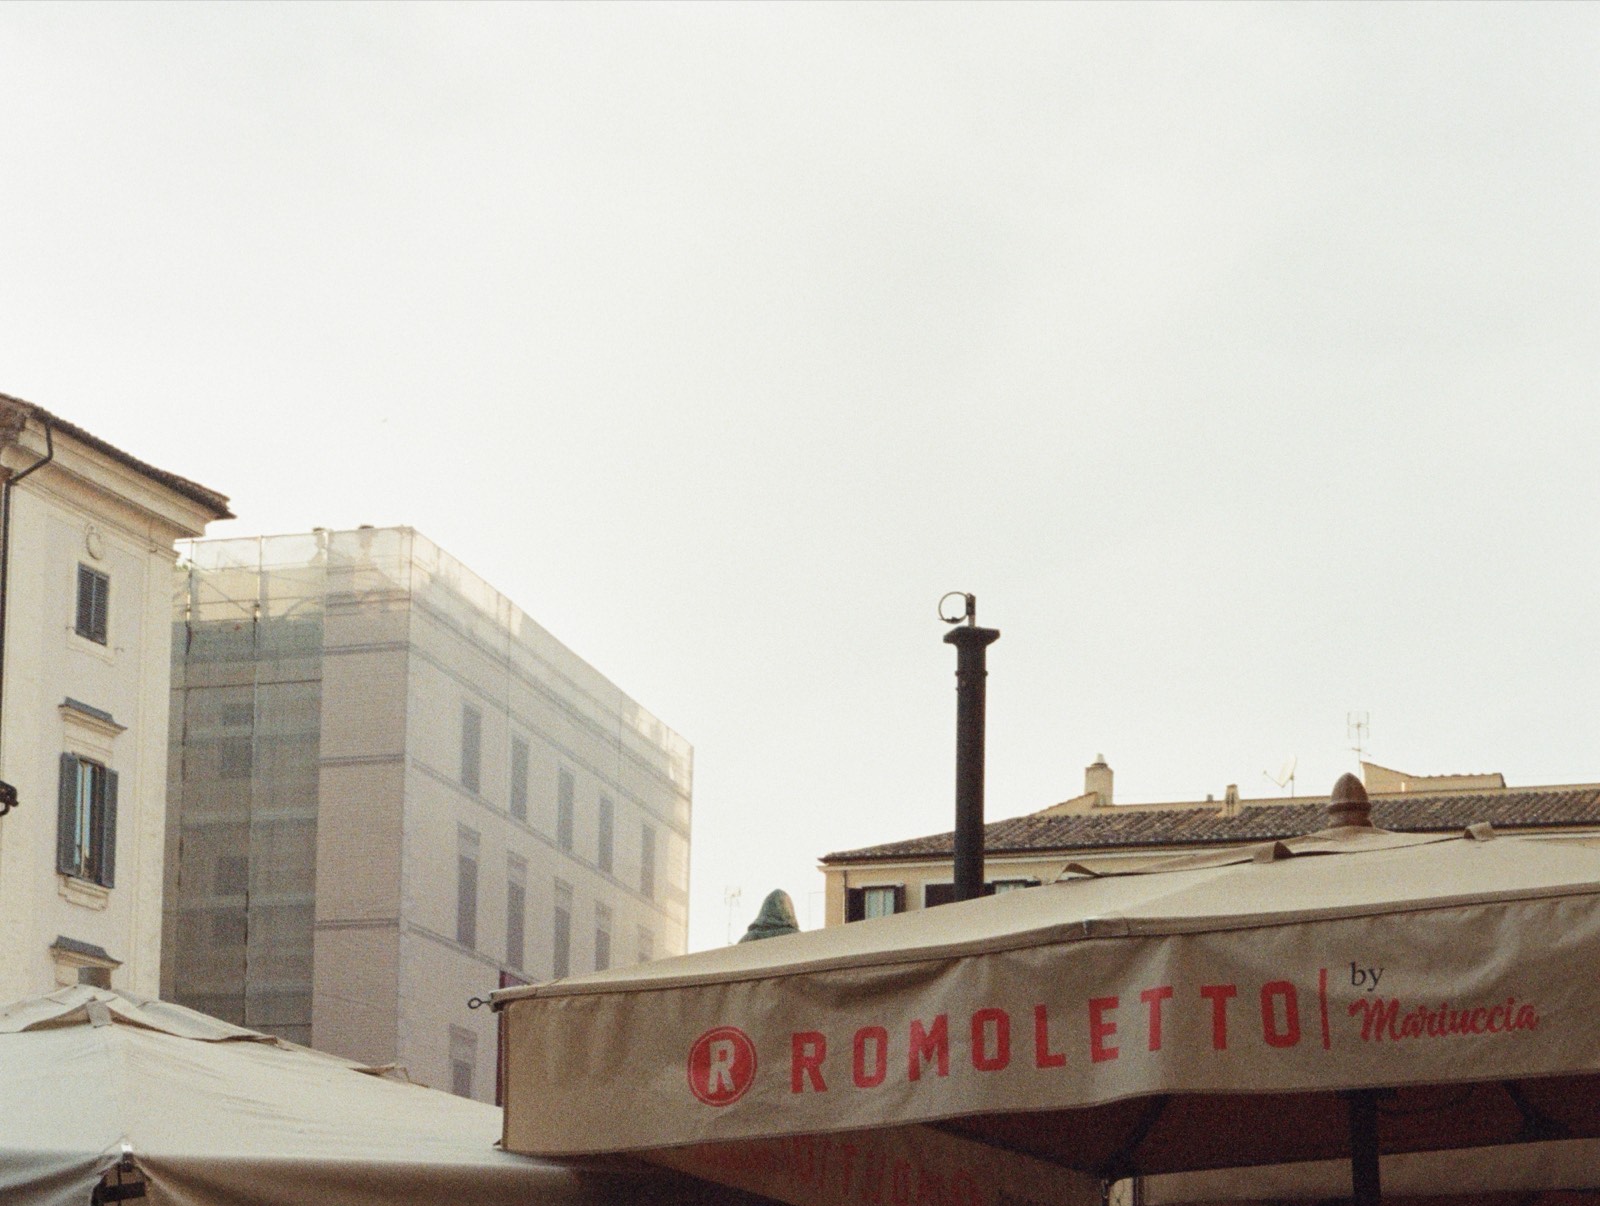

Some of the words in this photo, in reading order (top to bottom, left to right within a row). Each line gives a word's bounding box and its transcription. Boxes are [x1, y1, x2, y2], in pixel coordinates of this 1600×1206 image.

[1350, 961, 1385, 992] by
[790, 980, 1301, 1094] ROMOLETTO
[1347, 996, 1540, 1042] Mariuccia
